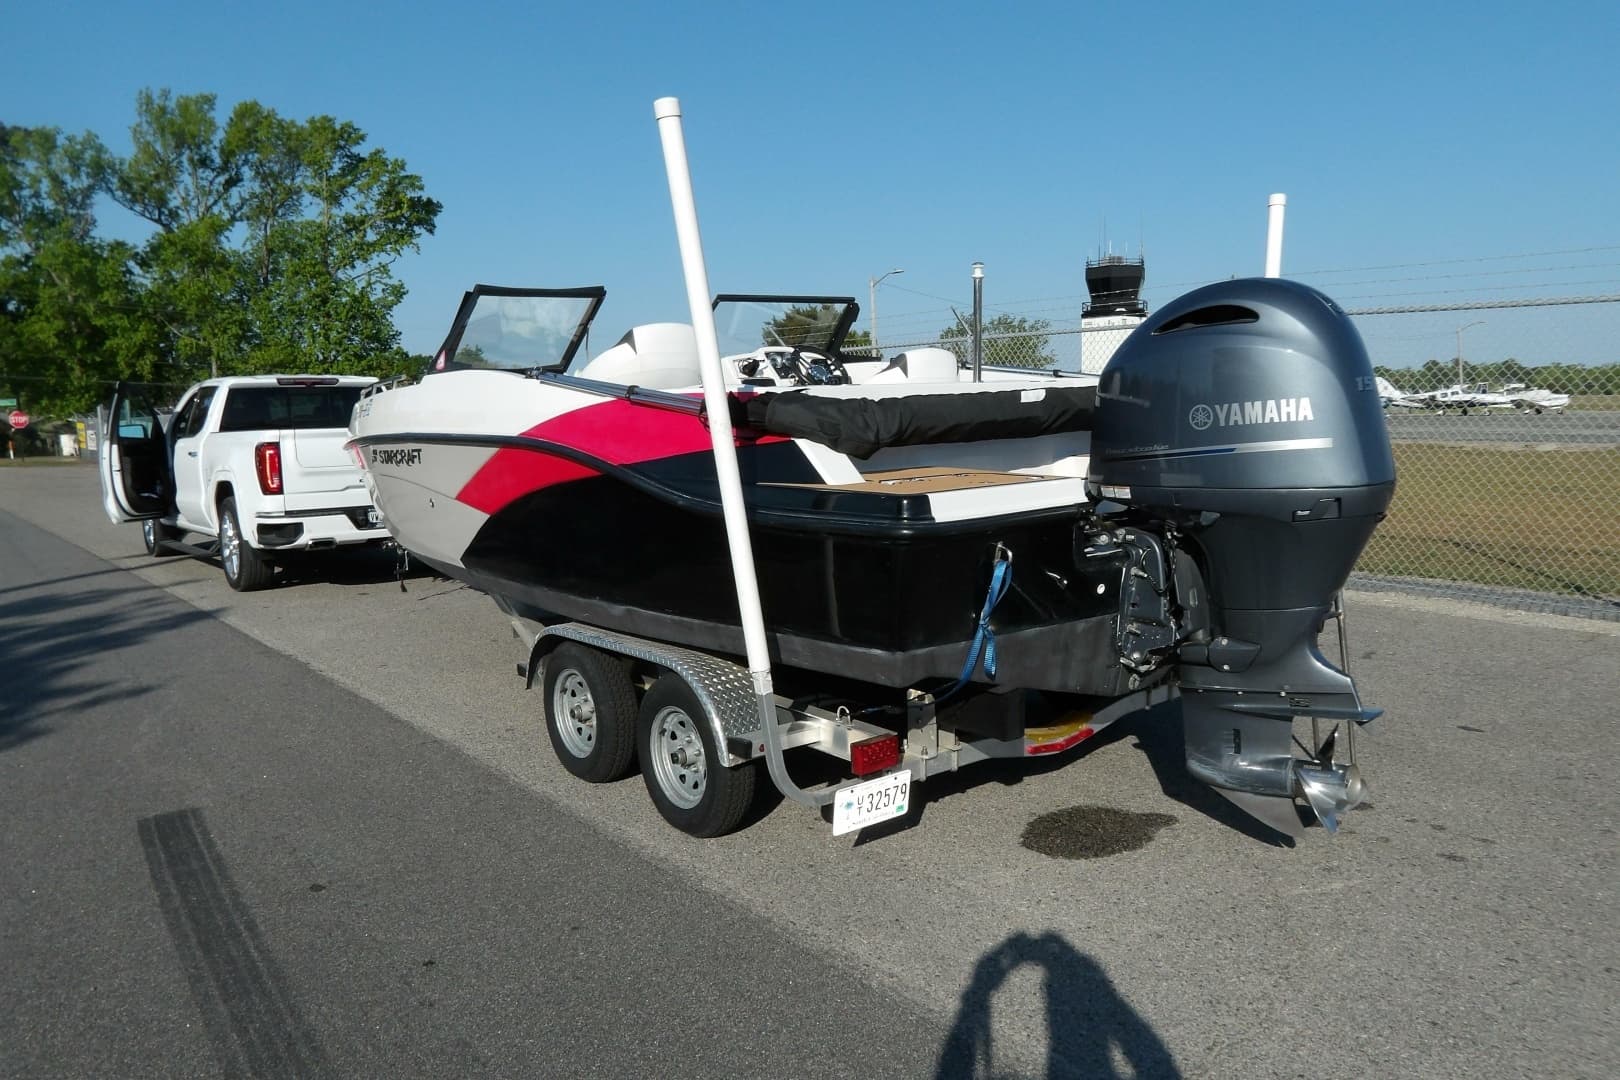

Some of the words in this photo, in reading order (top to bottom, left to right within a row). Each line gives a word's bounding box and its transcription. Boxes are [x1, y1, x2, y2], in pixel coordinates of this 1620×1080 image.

[10, 416, 28, 424] STOP
[1215, 397, 1314, 427] YAMAHA
[379, 448, 422, 467] STARCRAFT
[866, 783, 907, 813] 32579
